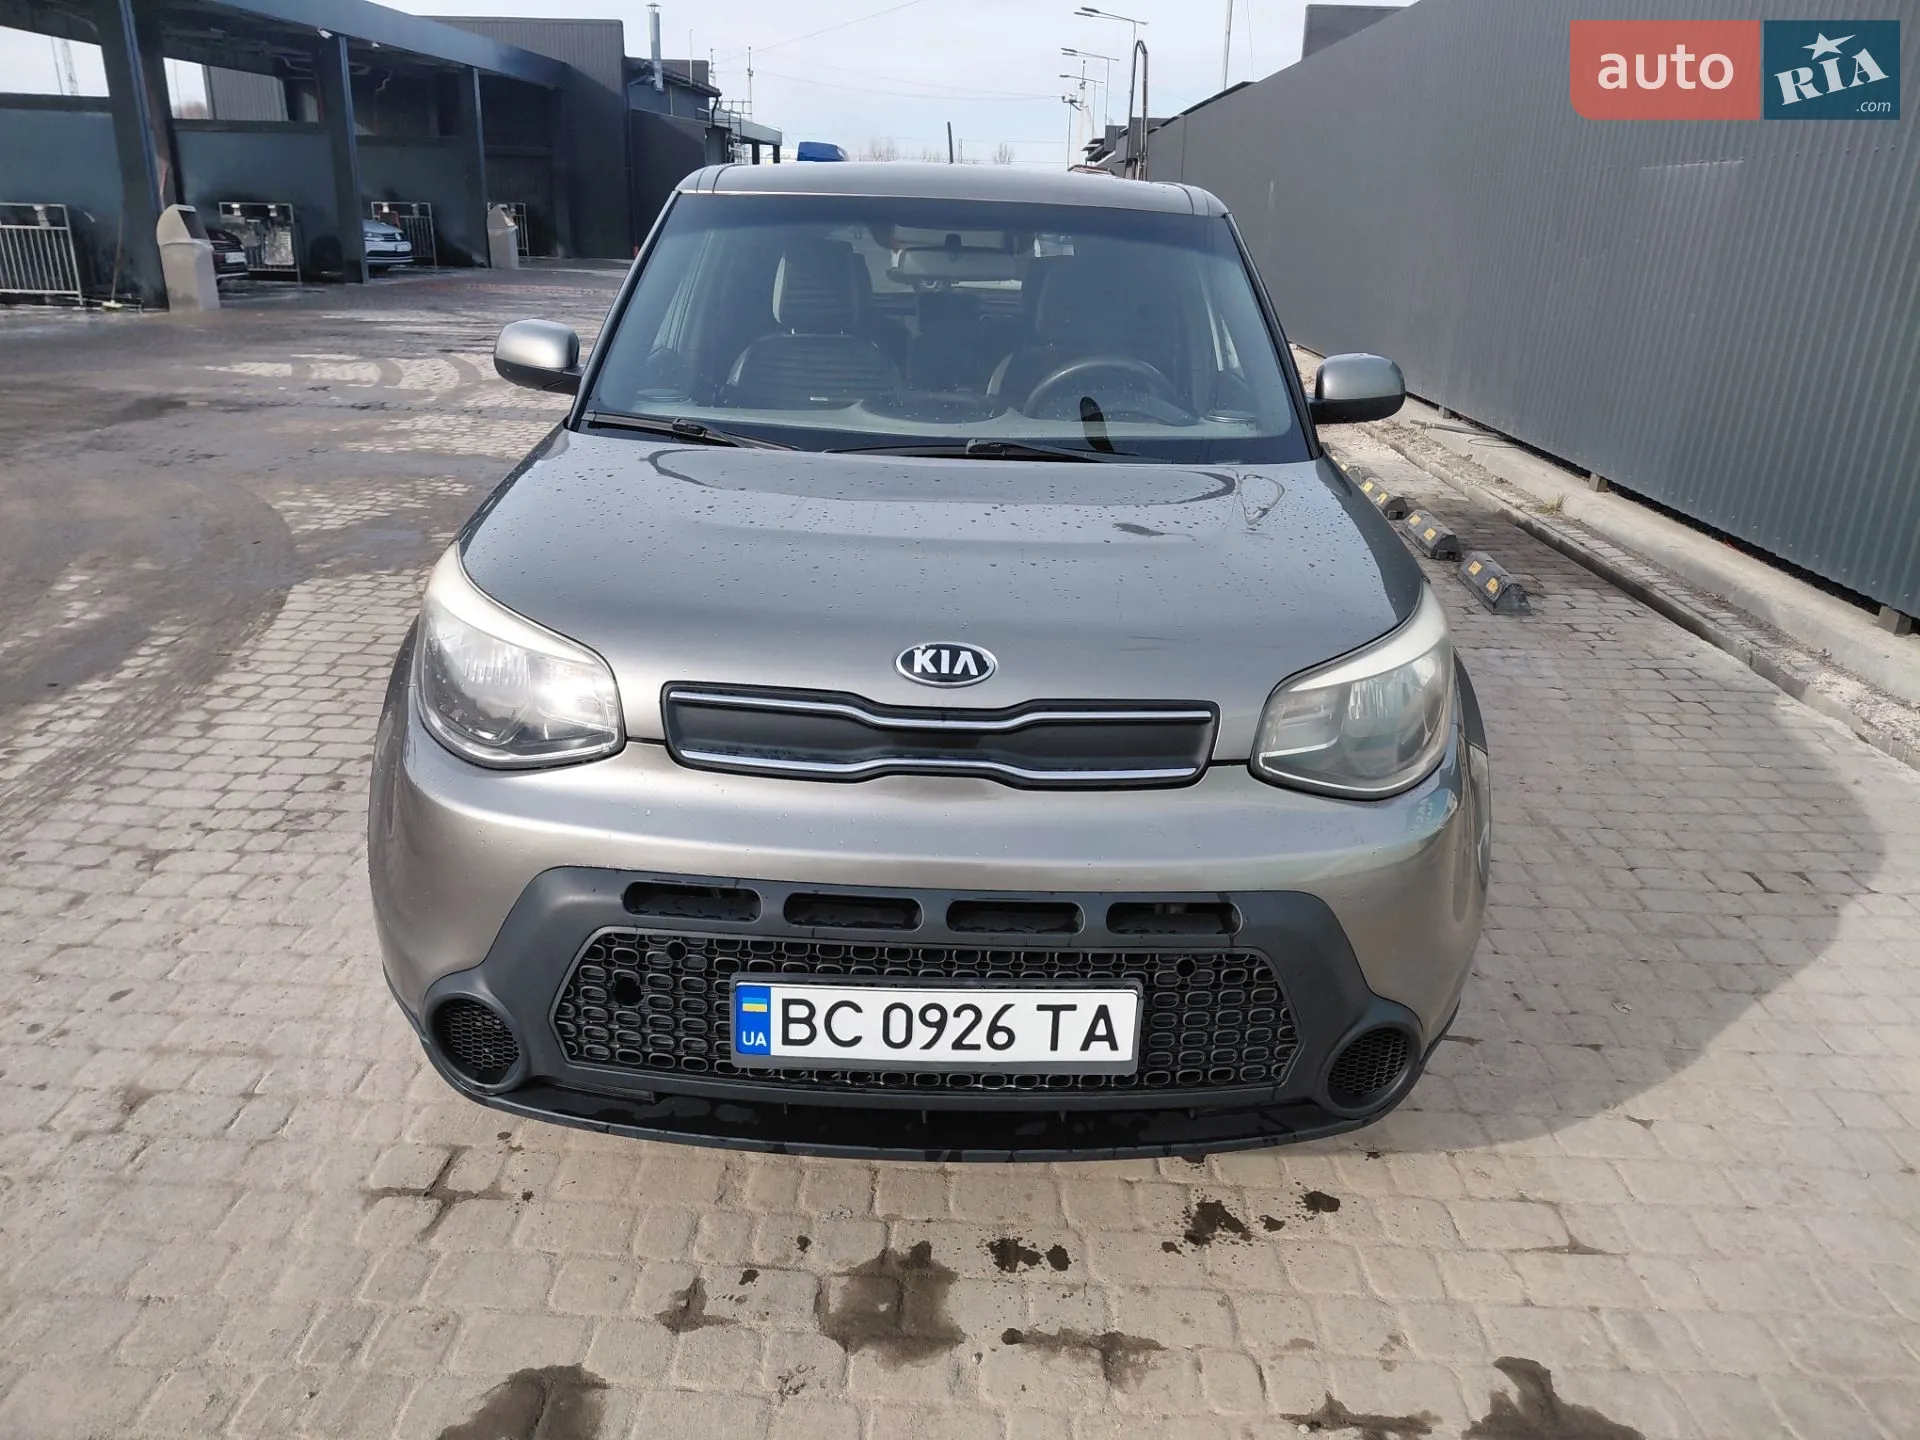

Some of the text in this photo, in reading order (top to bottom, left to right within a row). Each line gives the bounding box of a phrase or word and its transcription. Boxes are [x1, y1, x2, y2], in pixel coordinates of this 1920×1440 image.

[913, 648, 979, 676] KIA
[742, 1030, 767, 1047] UA
[781, 997, 1119, 1052] BC 0926 TA
